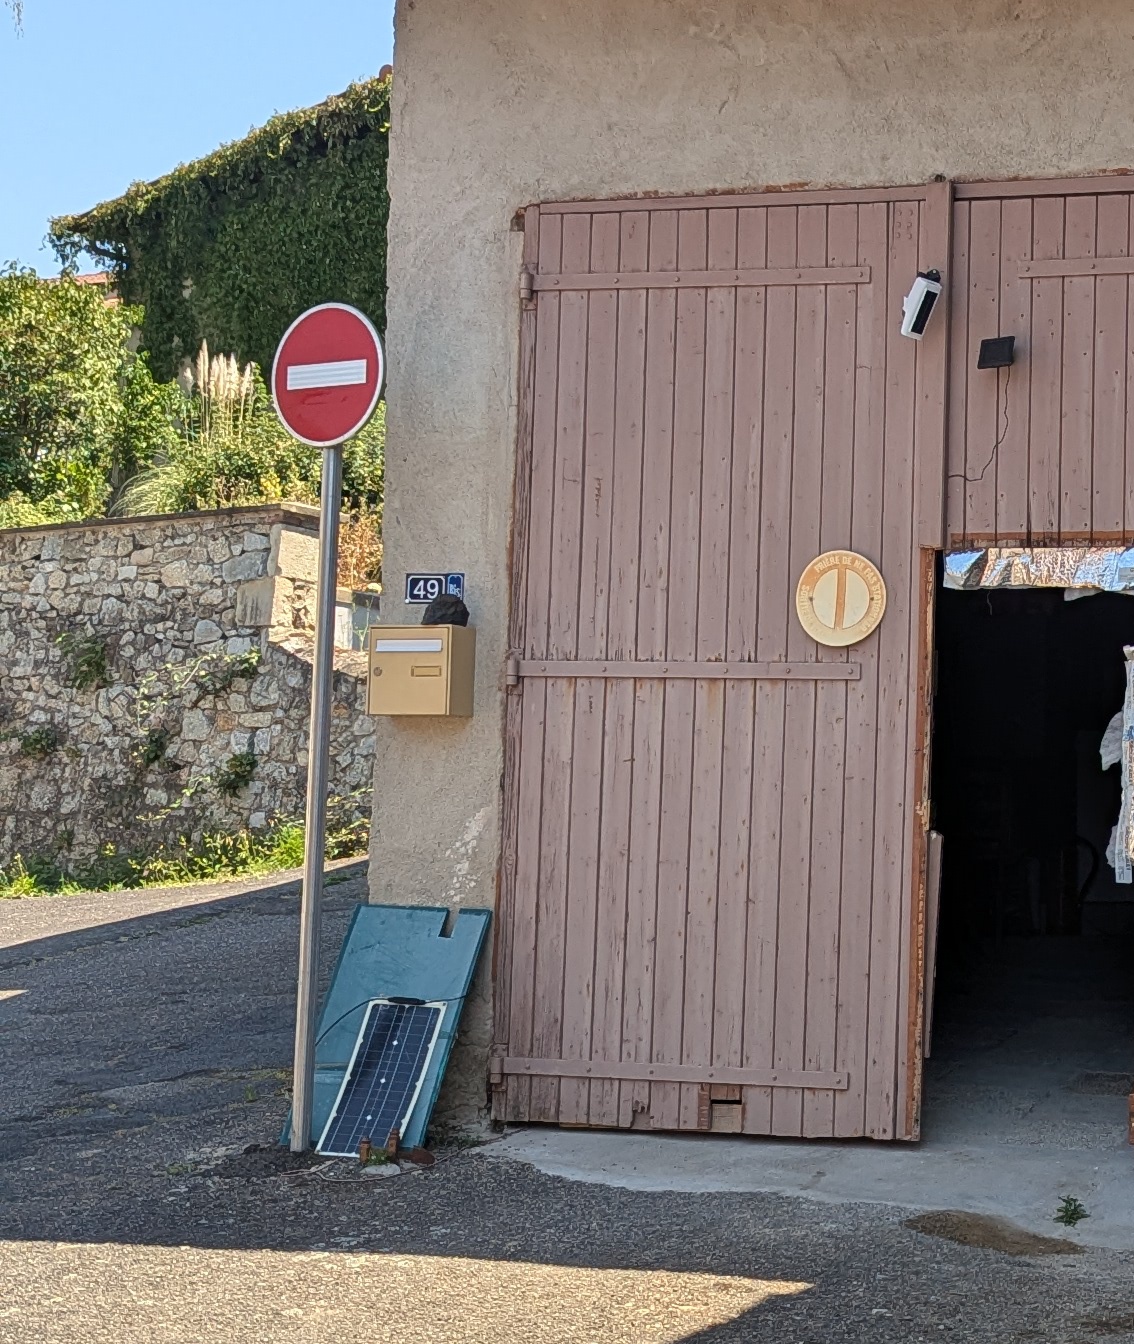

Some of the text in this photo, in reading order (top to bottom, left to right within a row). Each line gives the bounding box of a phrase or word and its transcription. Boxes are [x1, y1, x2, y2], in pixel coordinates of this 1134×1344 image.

[842, 556, 852, 565] DE
[863, 568, 877, 584] PAS
[413, 579, 439, 599] 49
